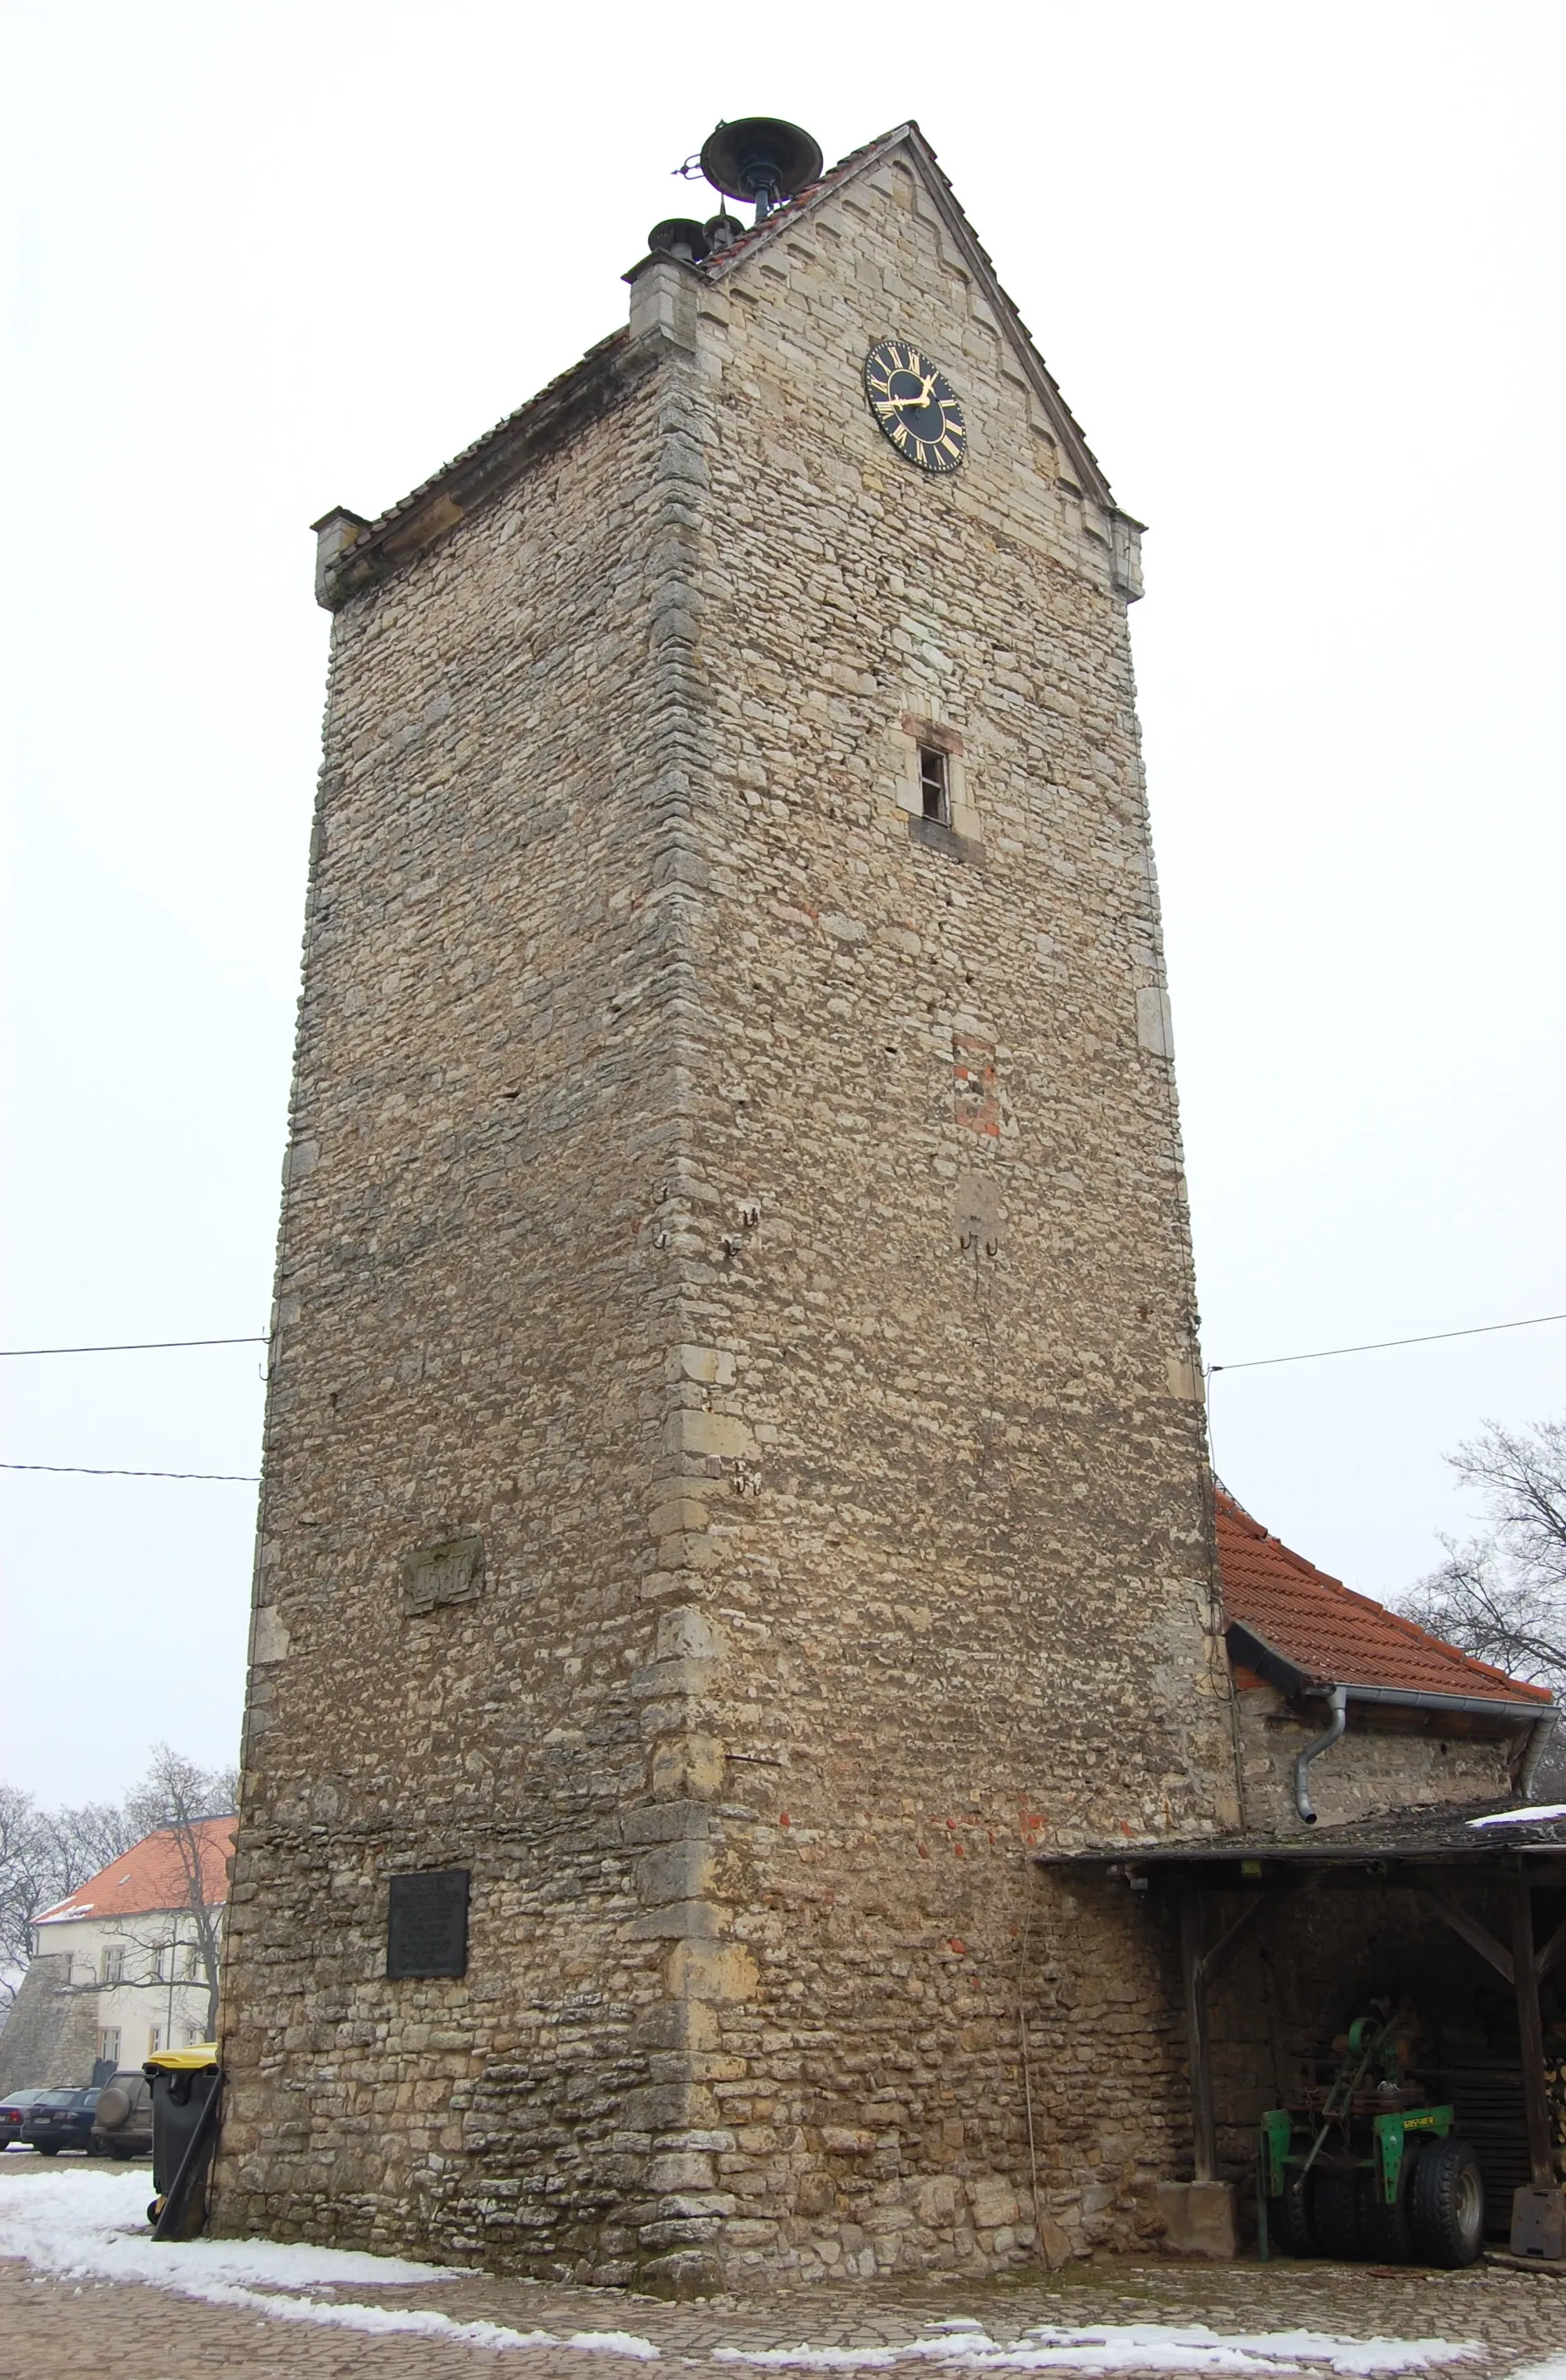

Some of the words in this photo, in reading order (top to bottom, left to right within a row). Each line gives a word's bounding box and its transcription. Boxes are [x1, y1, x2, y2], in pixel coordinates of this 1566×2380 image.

[875, 354, 892, 376] X
[908, 351, 920, 376] XII
[870, 374, 889, 394] IX
[893, 424, 908, 447] VII
[916, 440, 928, 464] VI
[934, 445, 946, 466] V
